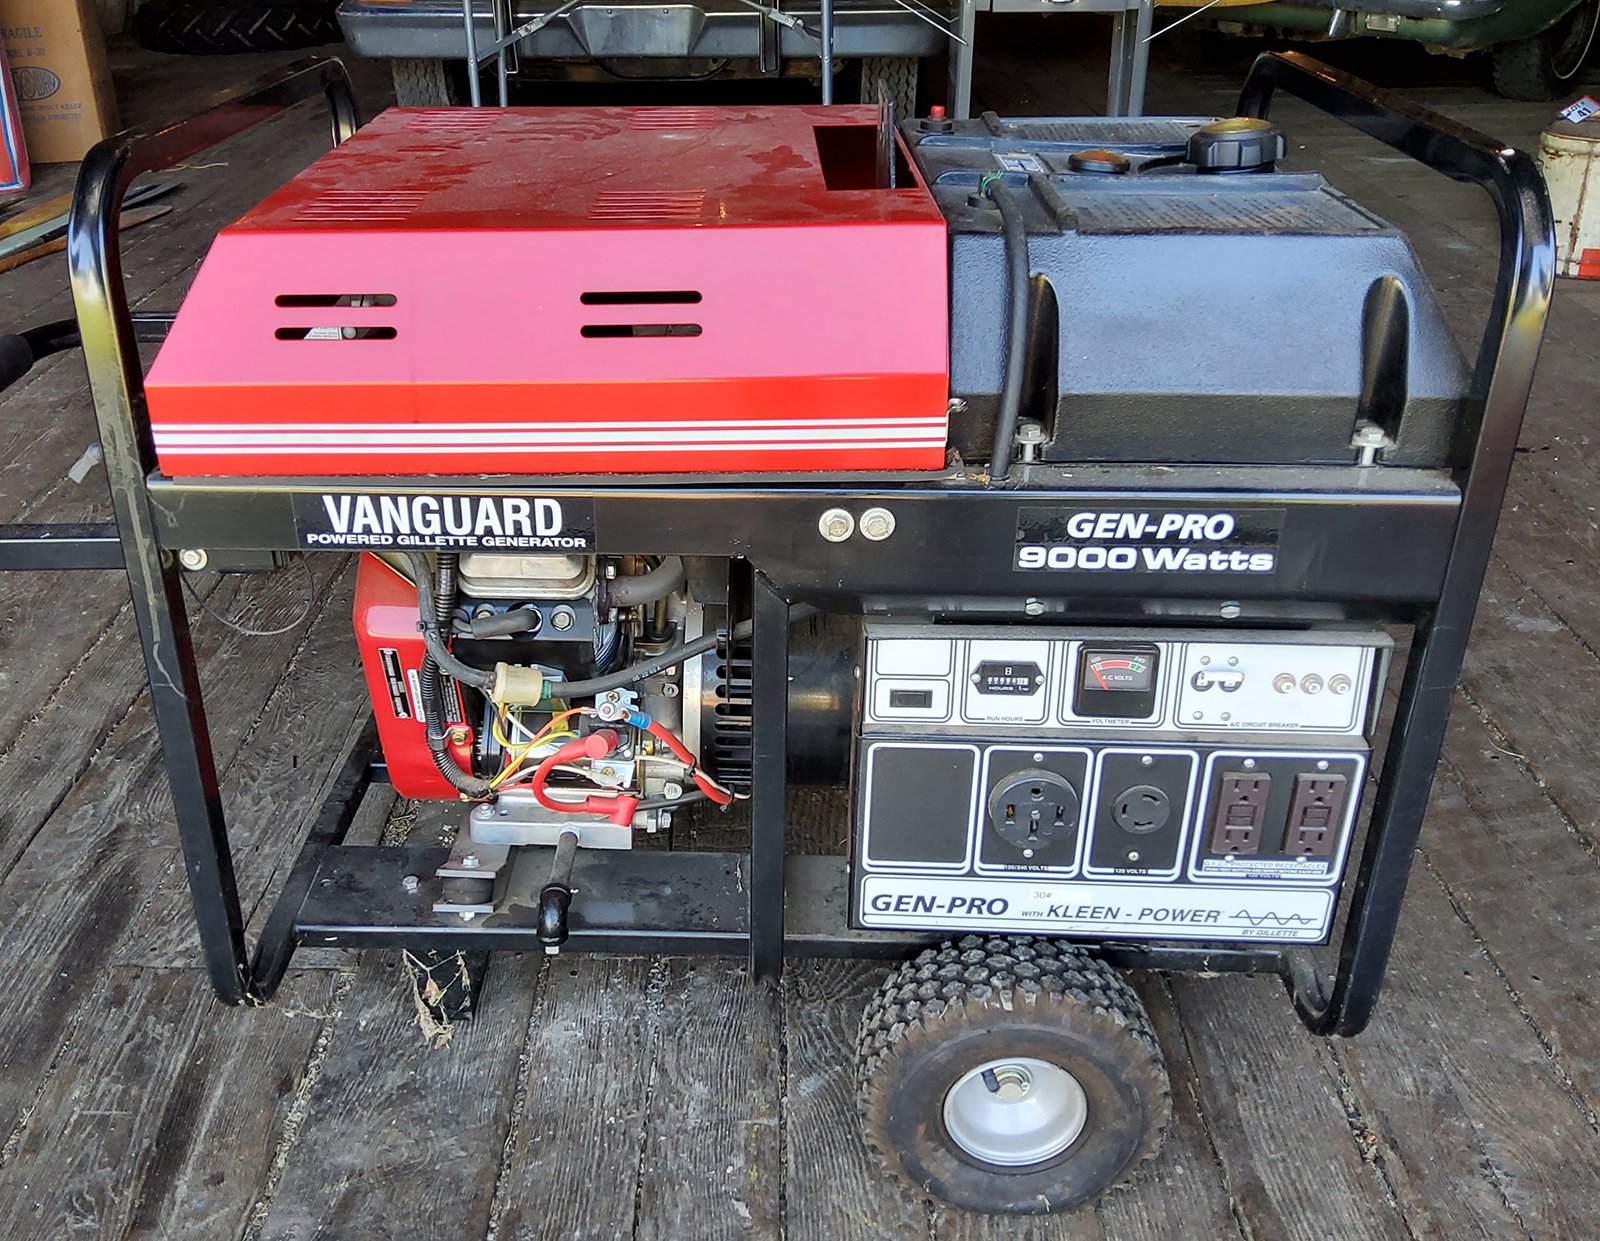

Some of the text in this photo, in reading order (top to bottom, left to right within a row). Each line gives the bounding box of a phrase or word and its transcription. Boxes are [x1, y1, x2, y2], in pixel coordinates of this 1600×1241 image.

[0, 26, 42, 39] RAGILE
[1578, 107, 1592, 117] 41
[322, 495, 563, 537] VANGUARD
[1066, 512, 1235, 541] GEN-PRO
[306, 533, 586, 548] POWERED GILLETTE GENERATOR
[1018, 546, 1274, 571] 9000 Watts
[870, 894, 1009, 915] GEN-PRO
[1021, 910, 1044, 918] WITH
[1047, 904, 1121, 920] KLEEN
[1138, 908, 1221, 924] POWER
[1256, 929, 1300, 938] GILLETTE
